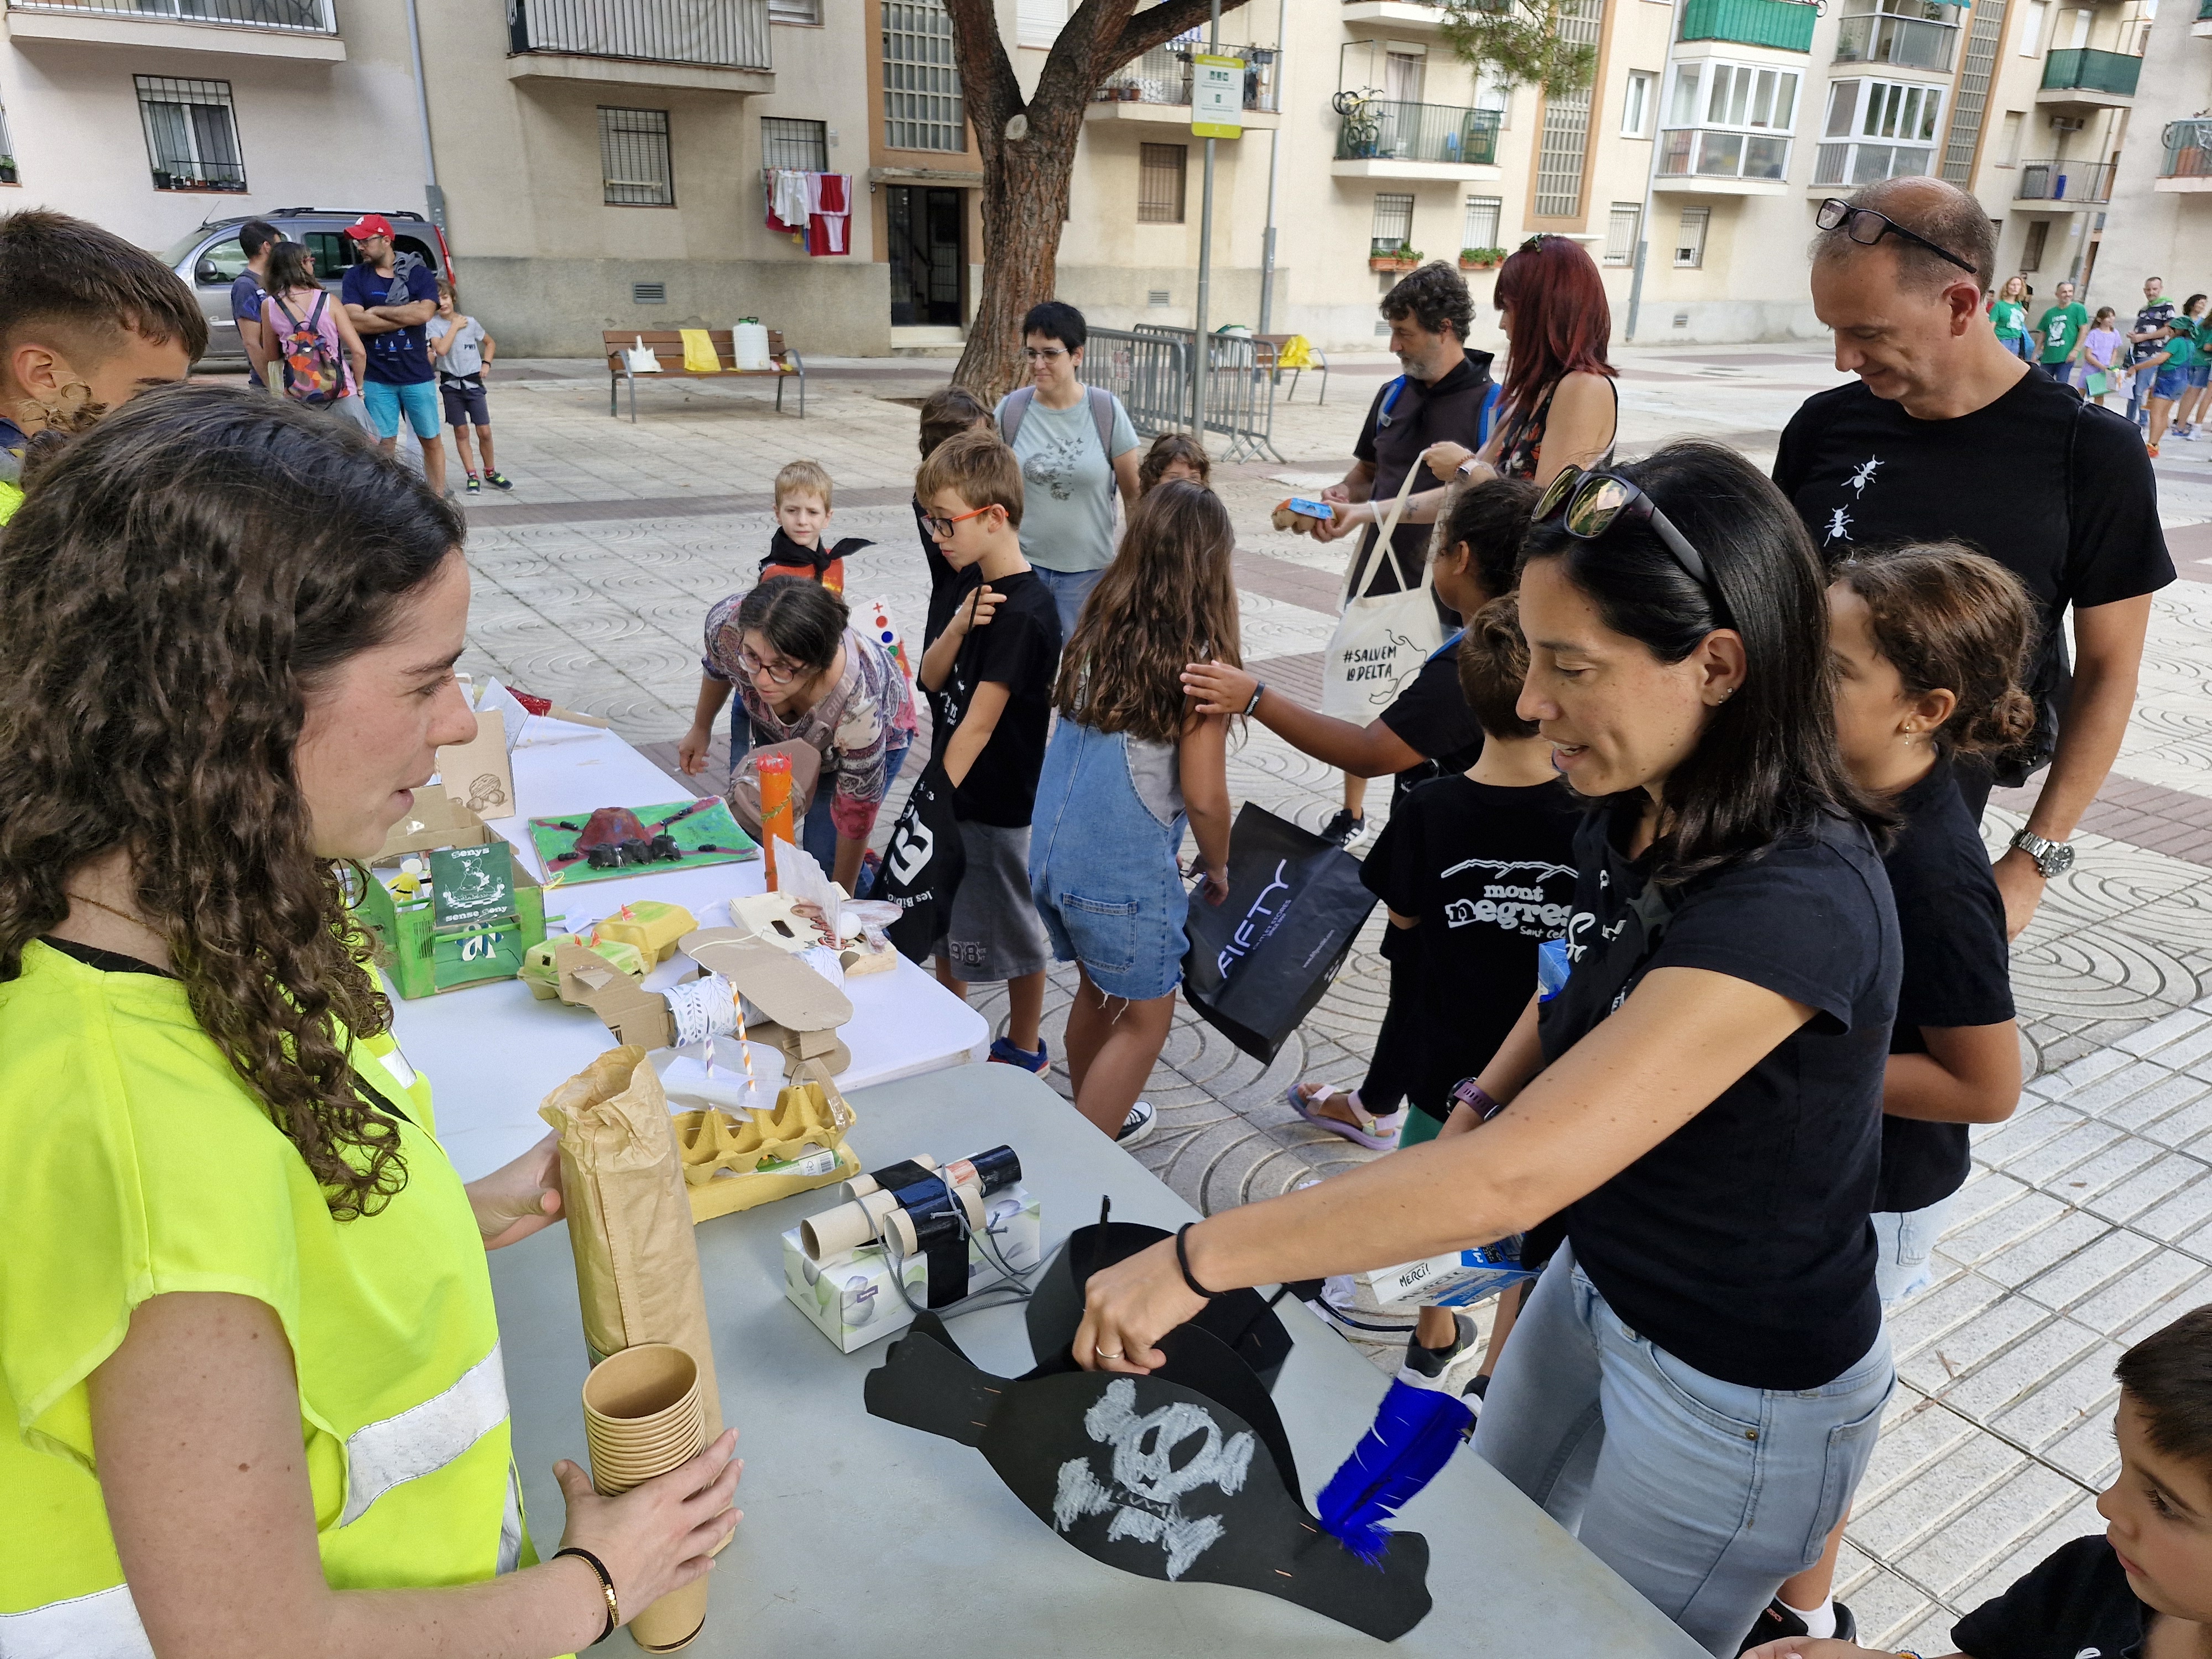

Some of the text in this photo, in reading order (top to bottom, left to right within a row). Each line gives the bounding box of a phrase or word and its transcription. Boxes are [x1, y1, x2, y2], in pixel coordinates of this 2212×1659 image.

[1342, 645, 1396, 663] #SALVEM
[1356, 663, 1392, 681] DELTA
[451, 847, 490, 859] Senys
[915, 890, 933, 903] les
[1484, 885, 1544, 902] mont
[445, 910, 479, 922] sense
[1218, 858, 1289, 979] FIFTY
